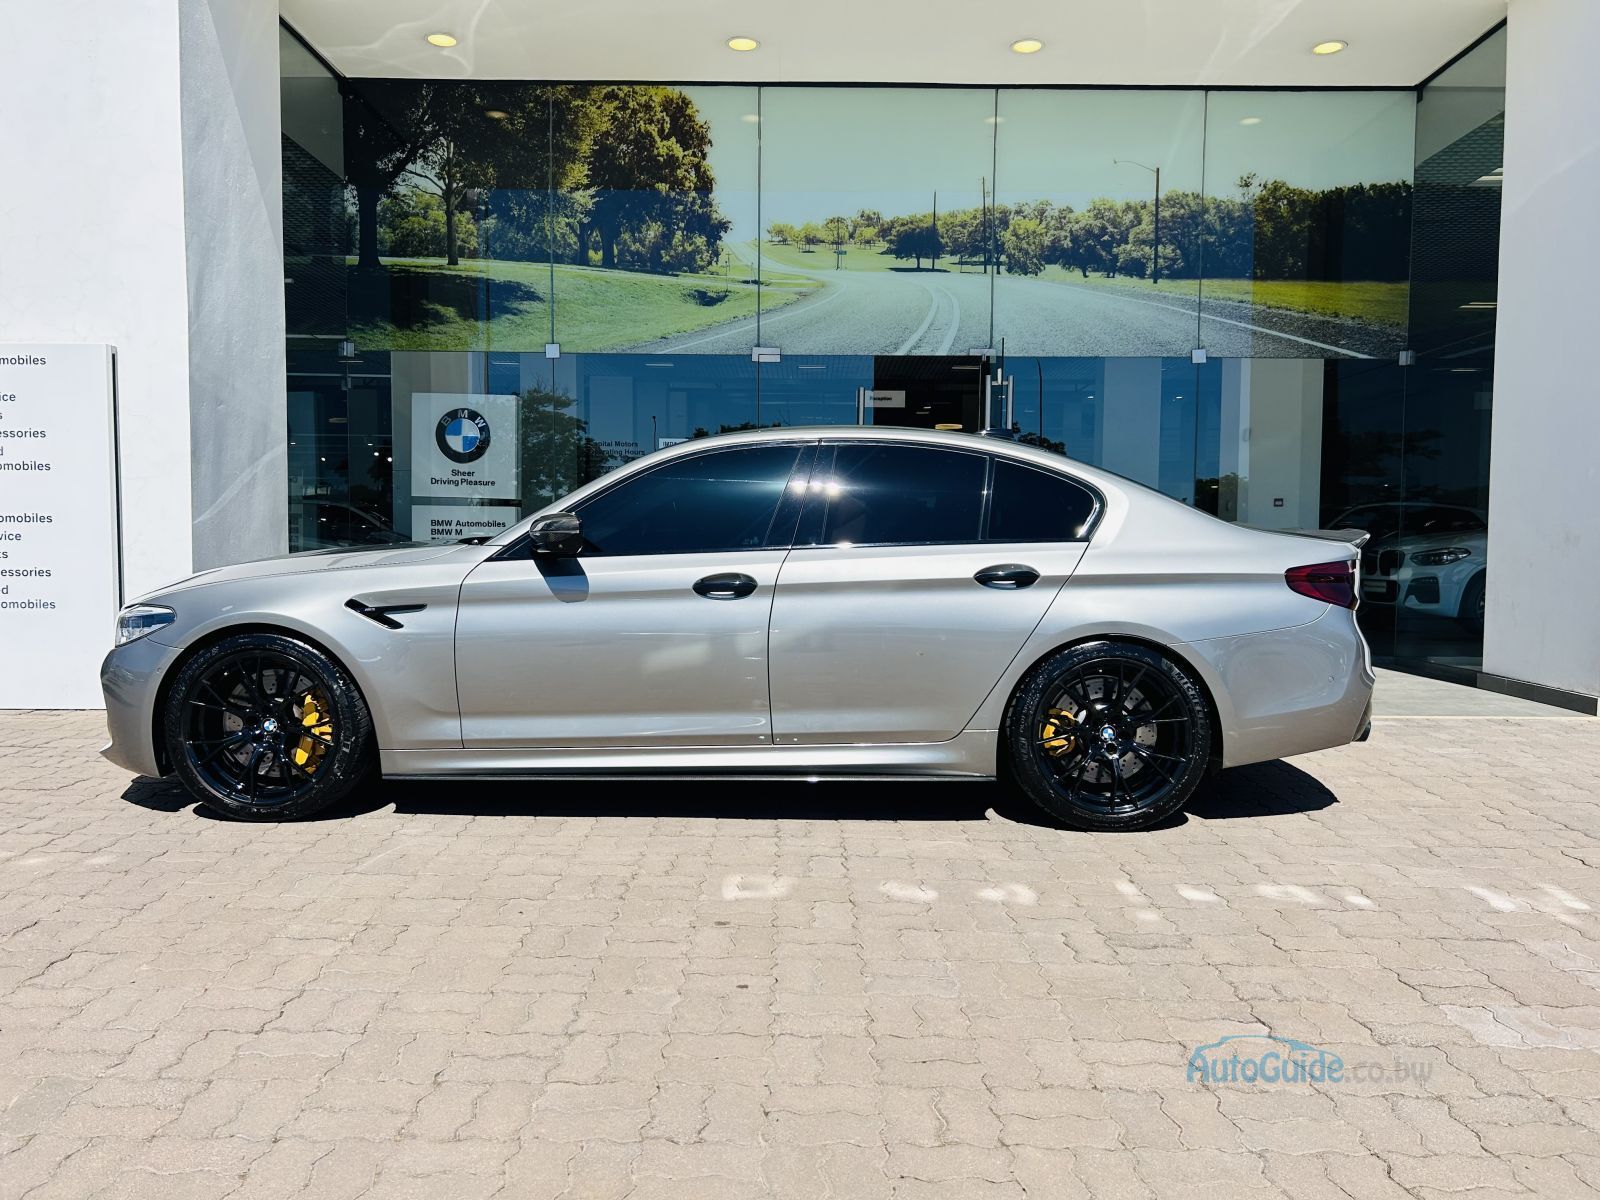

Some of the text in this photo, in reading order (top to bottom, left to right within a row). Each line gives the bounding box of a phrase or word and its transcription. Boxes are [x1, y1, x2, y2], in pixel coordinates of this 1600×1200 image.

[441, 409, 486, 428] BMW
[614, 440, 638, 448] Motors
[624, 448, 646, 457] Hours
[451, 469, 475, 477] Sheer
[430, 477, 496, 487] Driving Pleasure
[430, 519, 506, 528] BMW Automobiles
[430, 528, 463, 536] BMW M
[1175, 671, 1207, 729] MICHELIN
